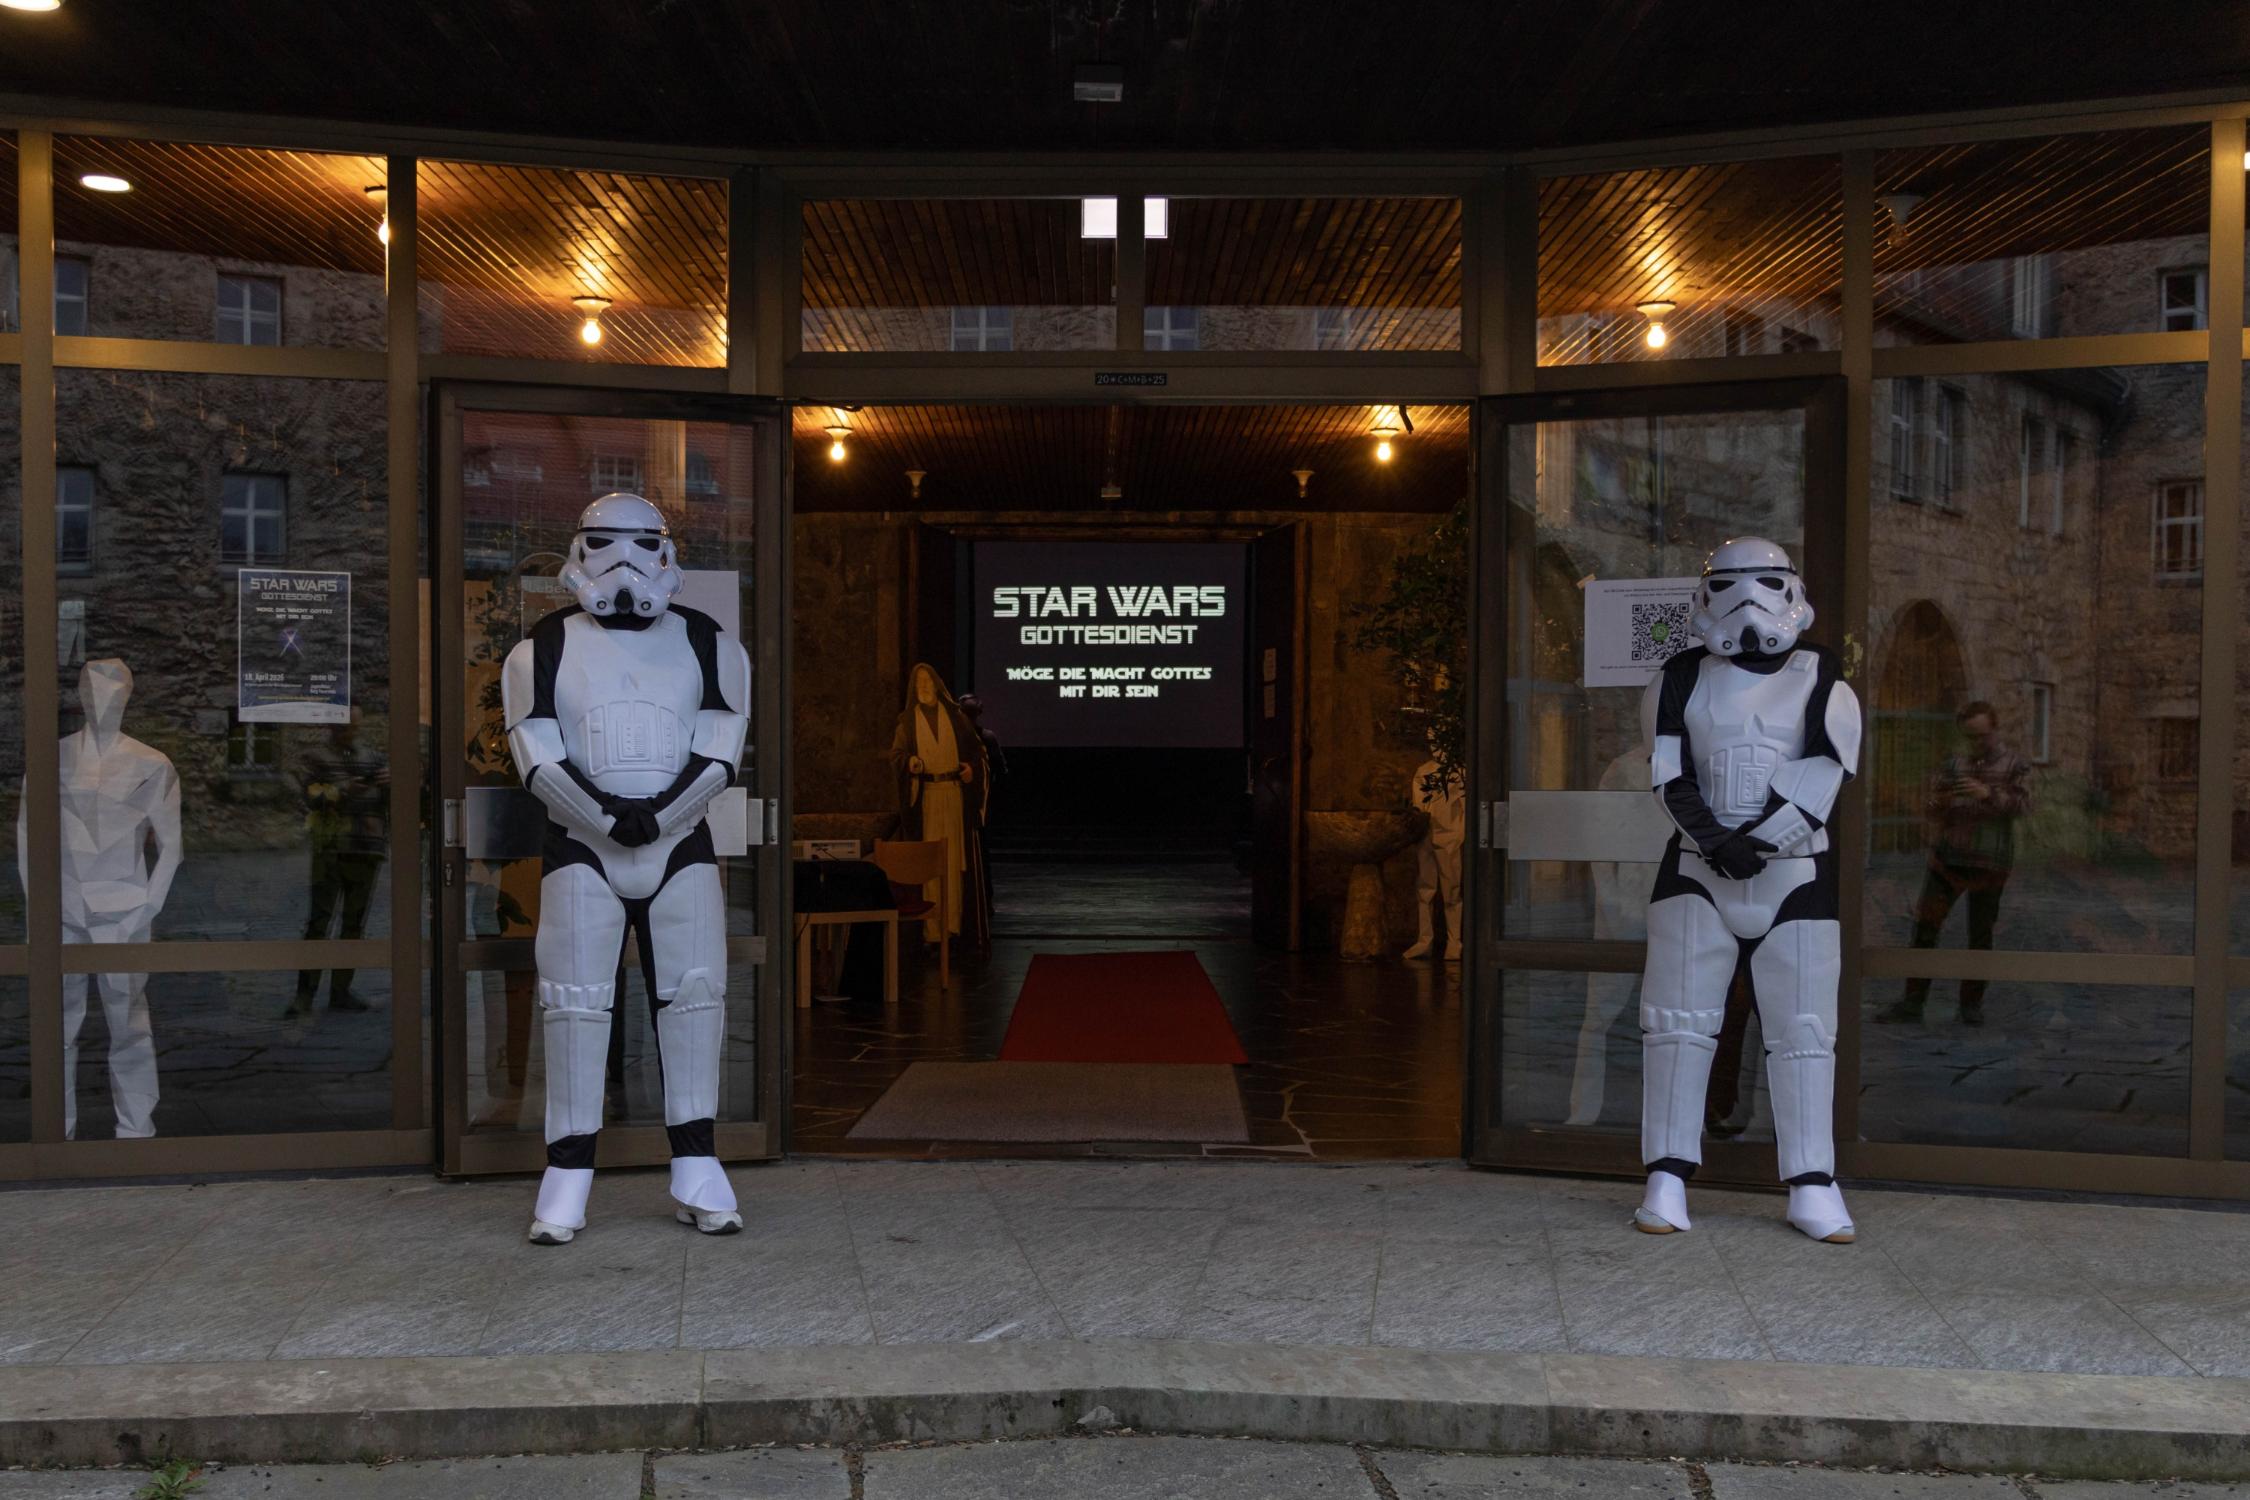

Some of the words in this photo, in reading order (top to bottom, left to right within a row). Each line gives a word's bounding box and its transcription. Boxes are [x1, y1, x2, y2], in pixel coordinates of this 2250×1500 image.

[250, 578, 290, 590] STAR
[293, 578, 338, 592] WARS
[261, 592, 328, 601] GOTTESDIENST
[993, 586, 1097, 618] STAR
[1107, 586, 1226, 618] WARS
[1020, 625, 1198, 645] GOTTESDIENST
[255, 673, 269, 682] April
[1006, 665, 1054, 680] MÖGE
[1060, 667, 1086, 680] DIE
[1090, 667, 1145, 680] MACHT
[1151, 667, 1212, 680] GOTTES
[1060, 685, 1086, 698] MIT
[1092, 685, 1120, 698] DIR
[1125, 685, 1158, 698] SEIN
